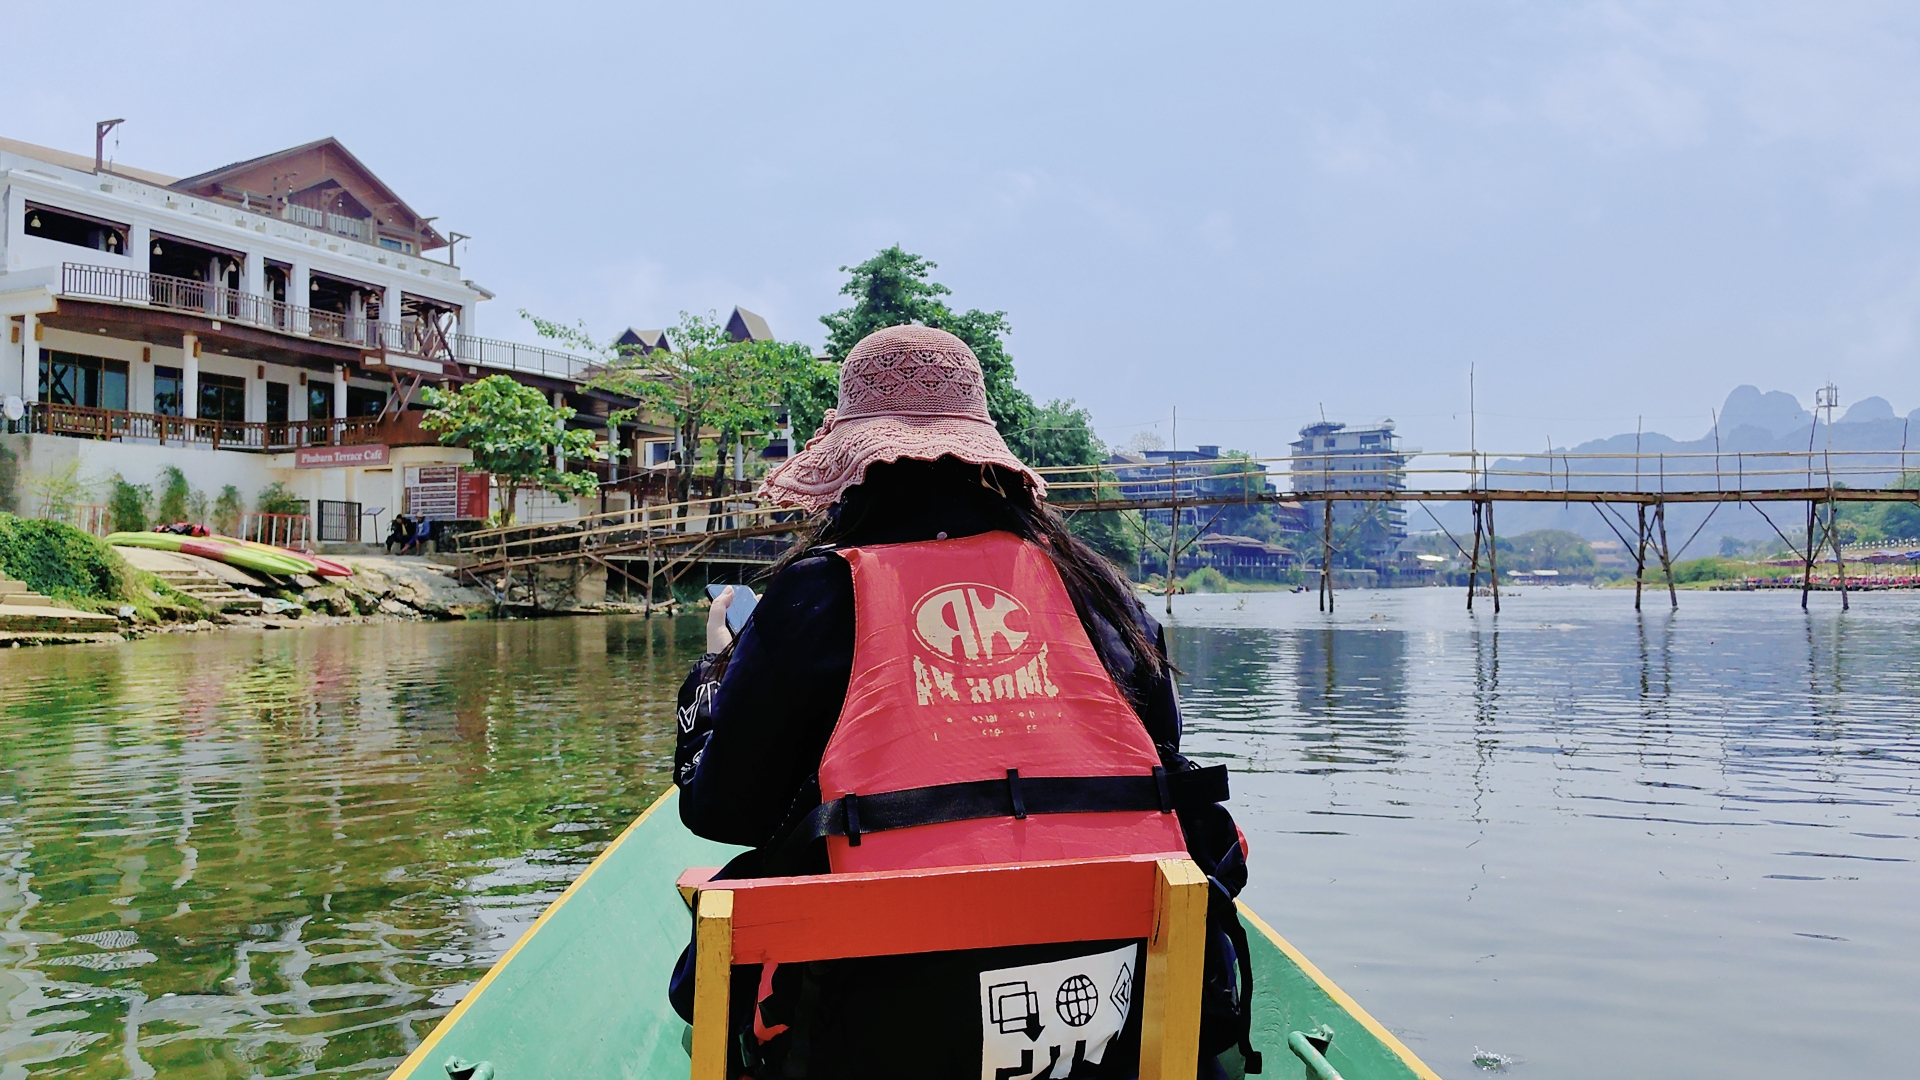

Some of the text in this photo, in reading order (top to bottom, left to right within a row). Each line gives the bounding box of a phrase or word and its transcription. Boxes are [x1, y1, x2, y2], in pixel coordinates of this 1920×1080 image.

[301, 449, 383, 463] Phubarn Terrace Café
